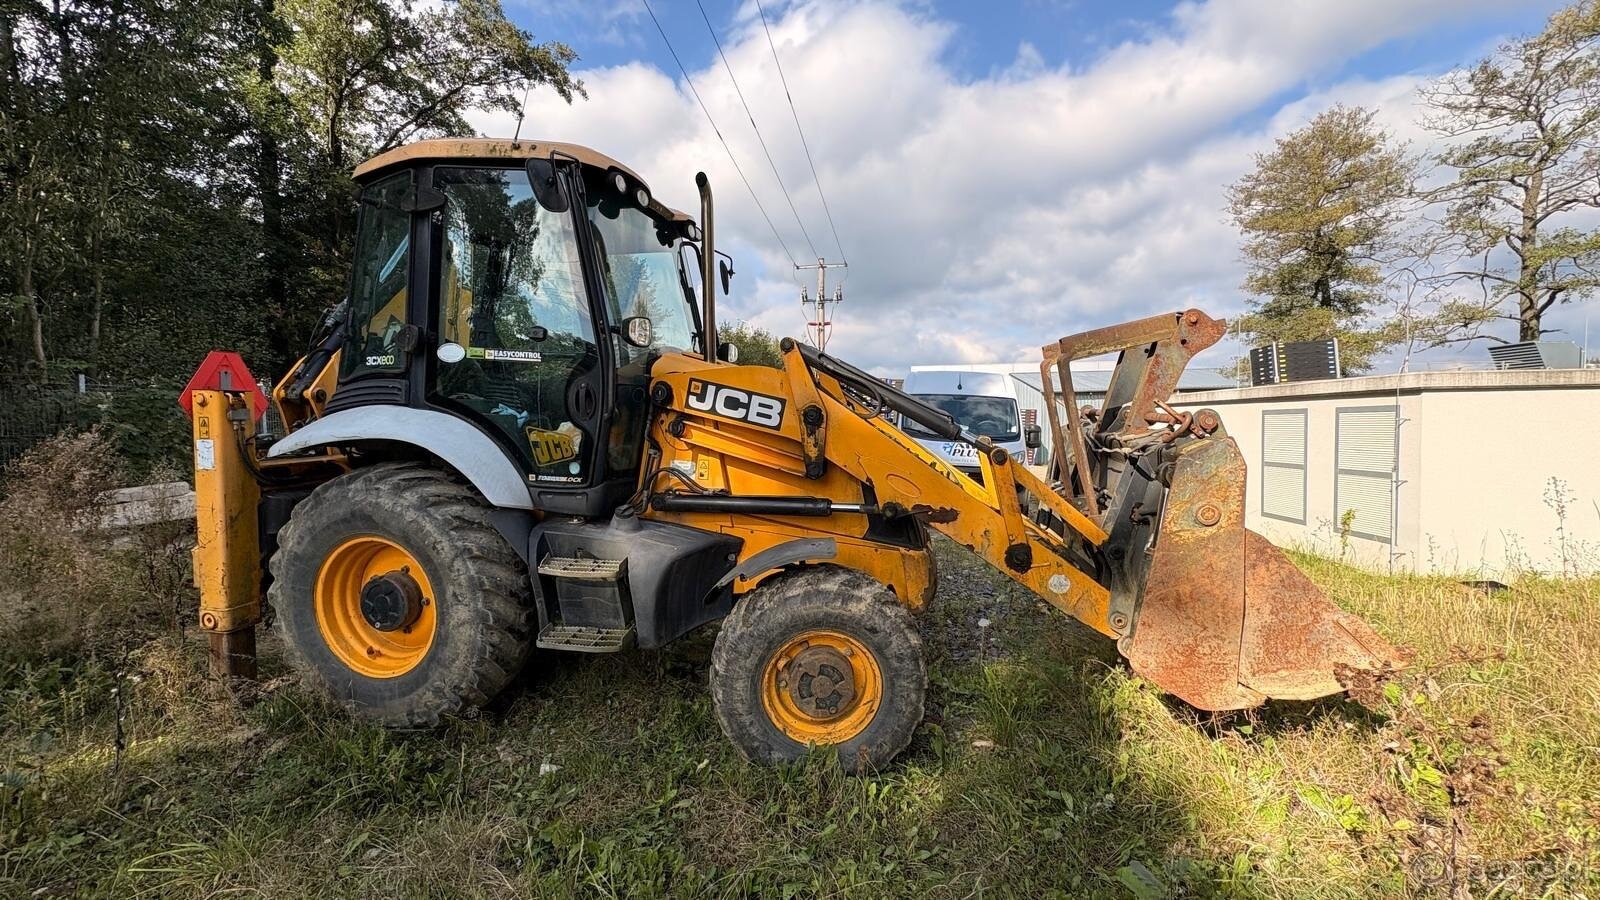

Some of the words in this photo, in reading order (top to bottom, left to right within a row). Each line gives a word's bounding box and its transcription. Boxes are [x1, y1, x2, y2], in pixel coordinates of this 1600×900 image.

[494, 350, 542, 359] EASYCONTROL
[688, 384, 782, 427] JCB
[529, 430, 574, 464] JCB
